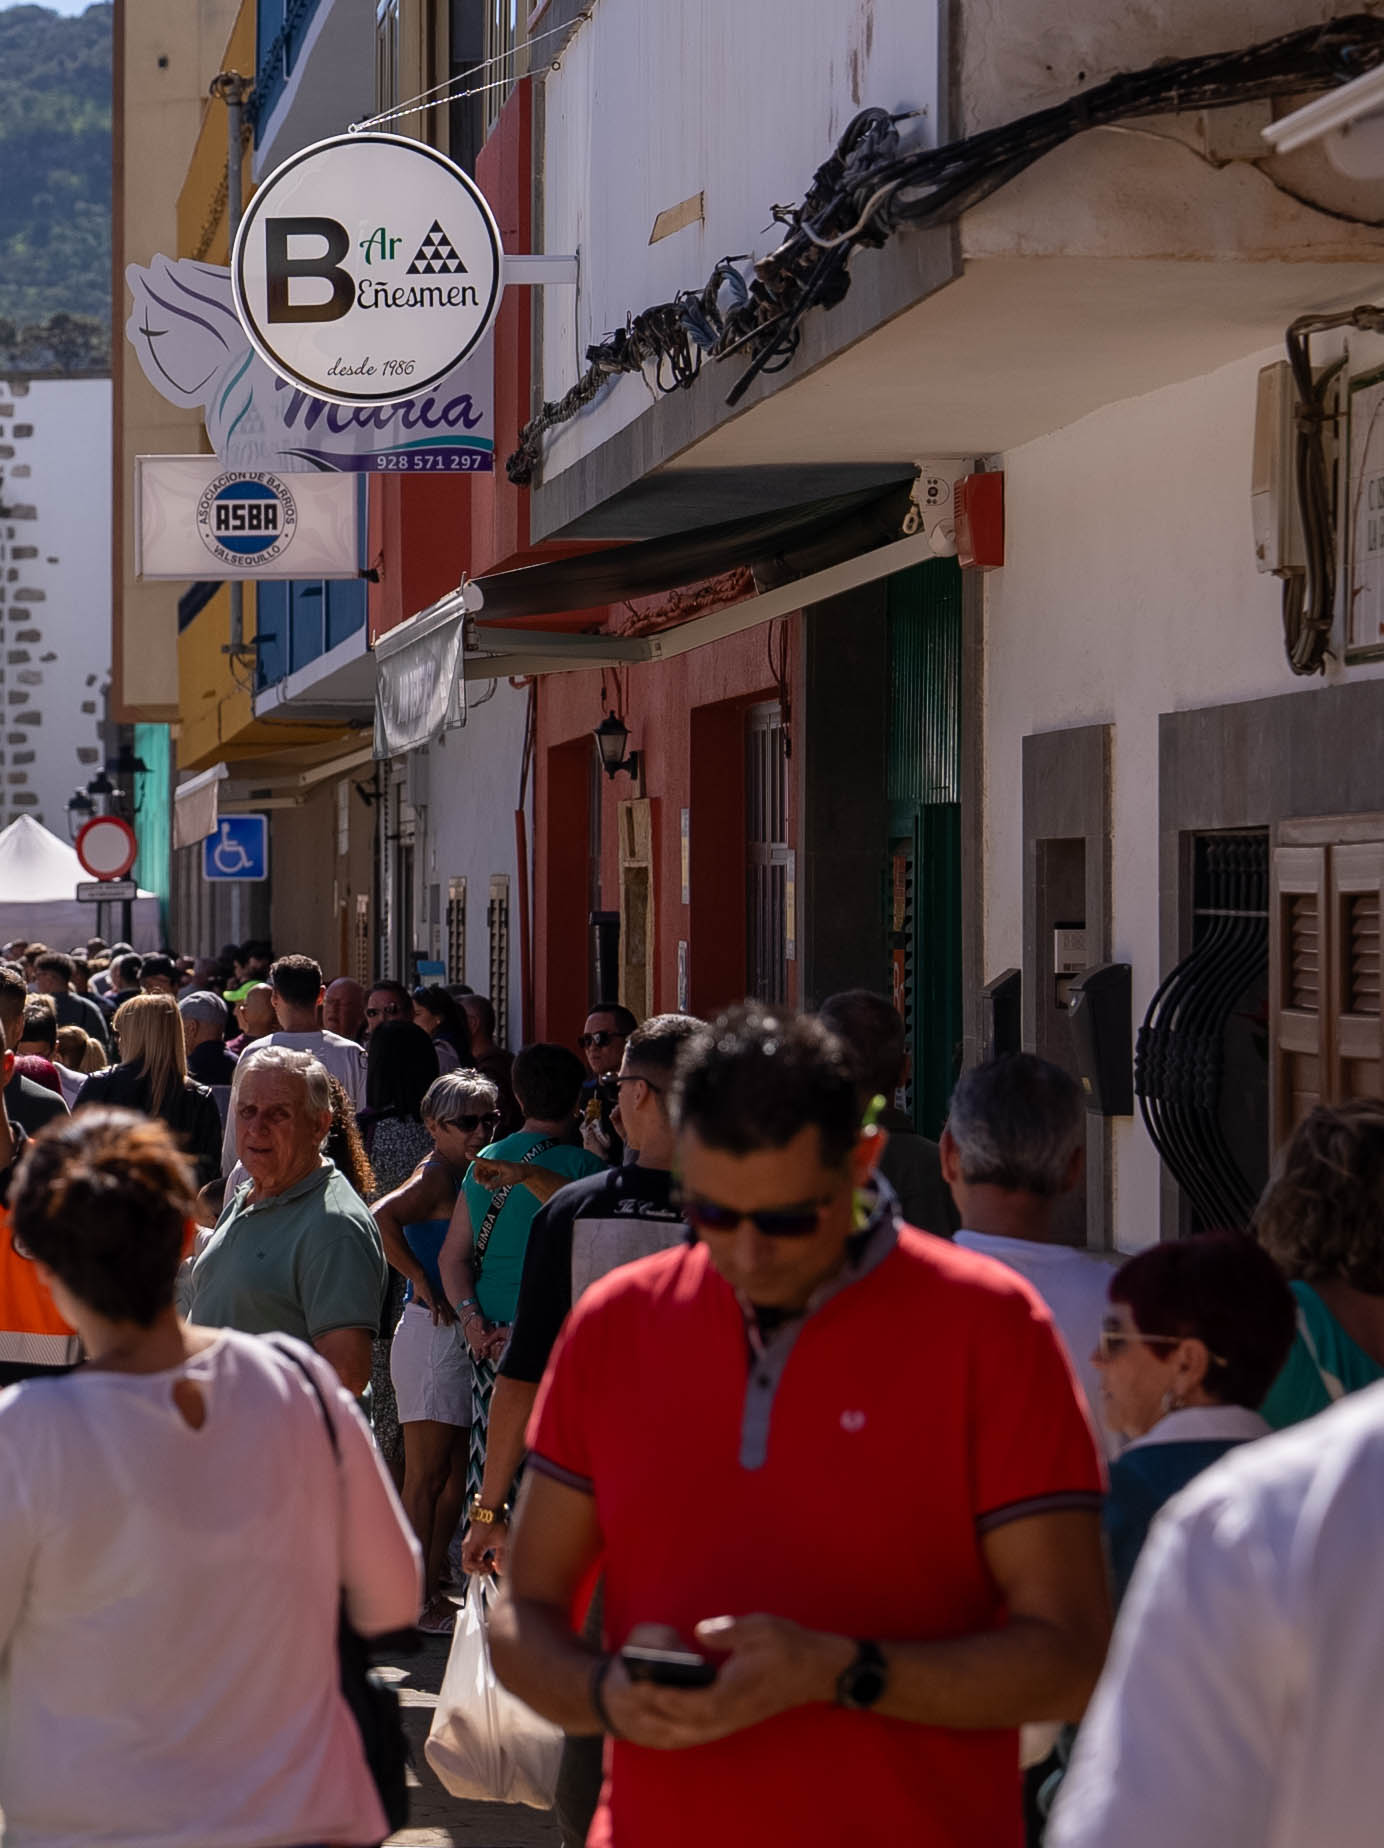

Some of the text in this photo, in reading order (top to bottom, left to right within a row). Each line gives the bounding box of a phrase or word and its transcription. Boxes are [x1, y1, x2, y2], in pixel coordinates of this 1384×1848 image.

[359, 227, 403, 266] Ar
[265, 216, 356, 325] B
[356, 278, 480, 309] Eñesmen
[327, 356, 418, 377] desde 1986
[376, 455, 482, 469] 928 571 297
[249, 471, 266, 481] DE
[266, 476, 295, 525] BARRIOS
[216, 504, 278, 531] ASBA
[214, 544, 281, 565] VALSEQUILLO
[477, 1213, 496, 1250] BIMBA
